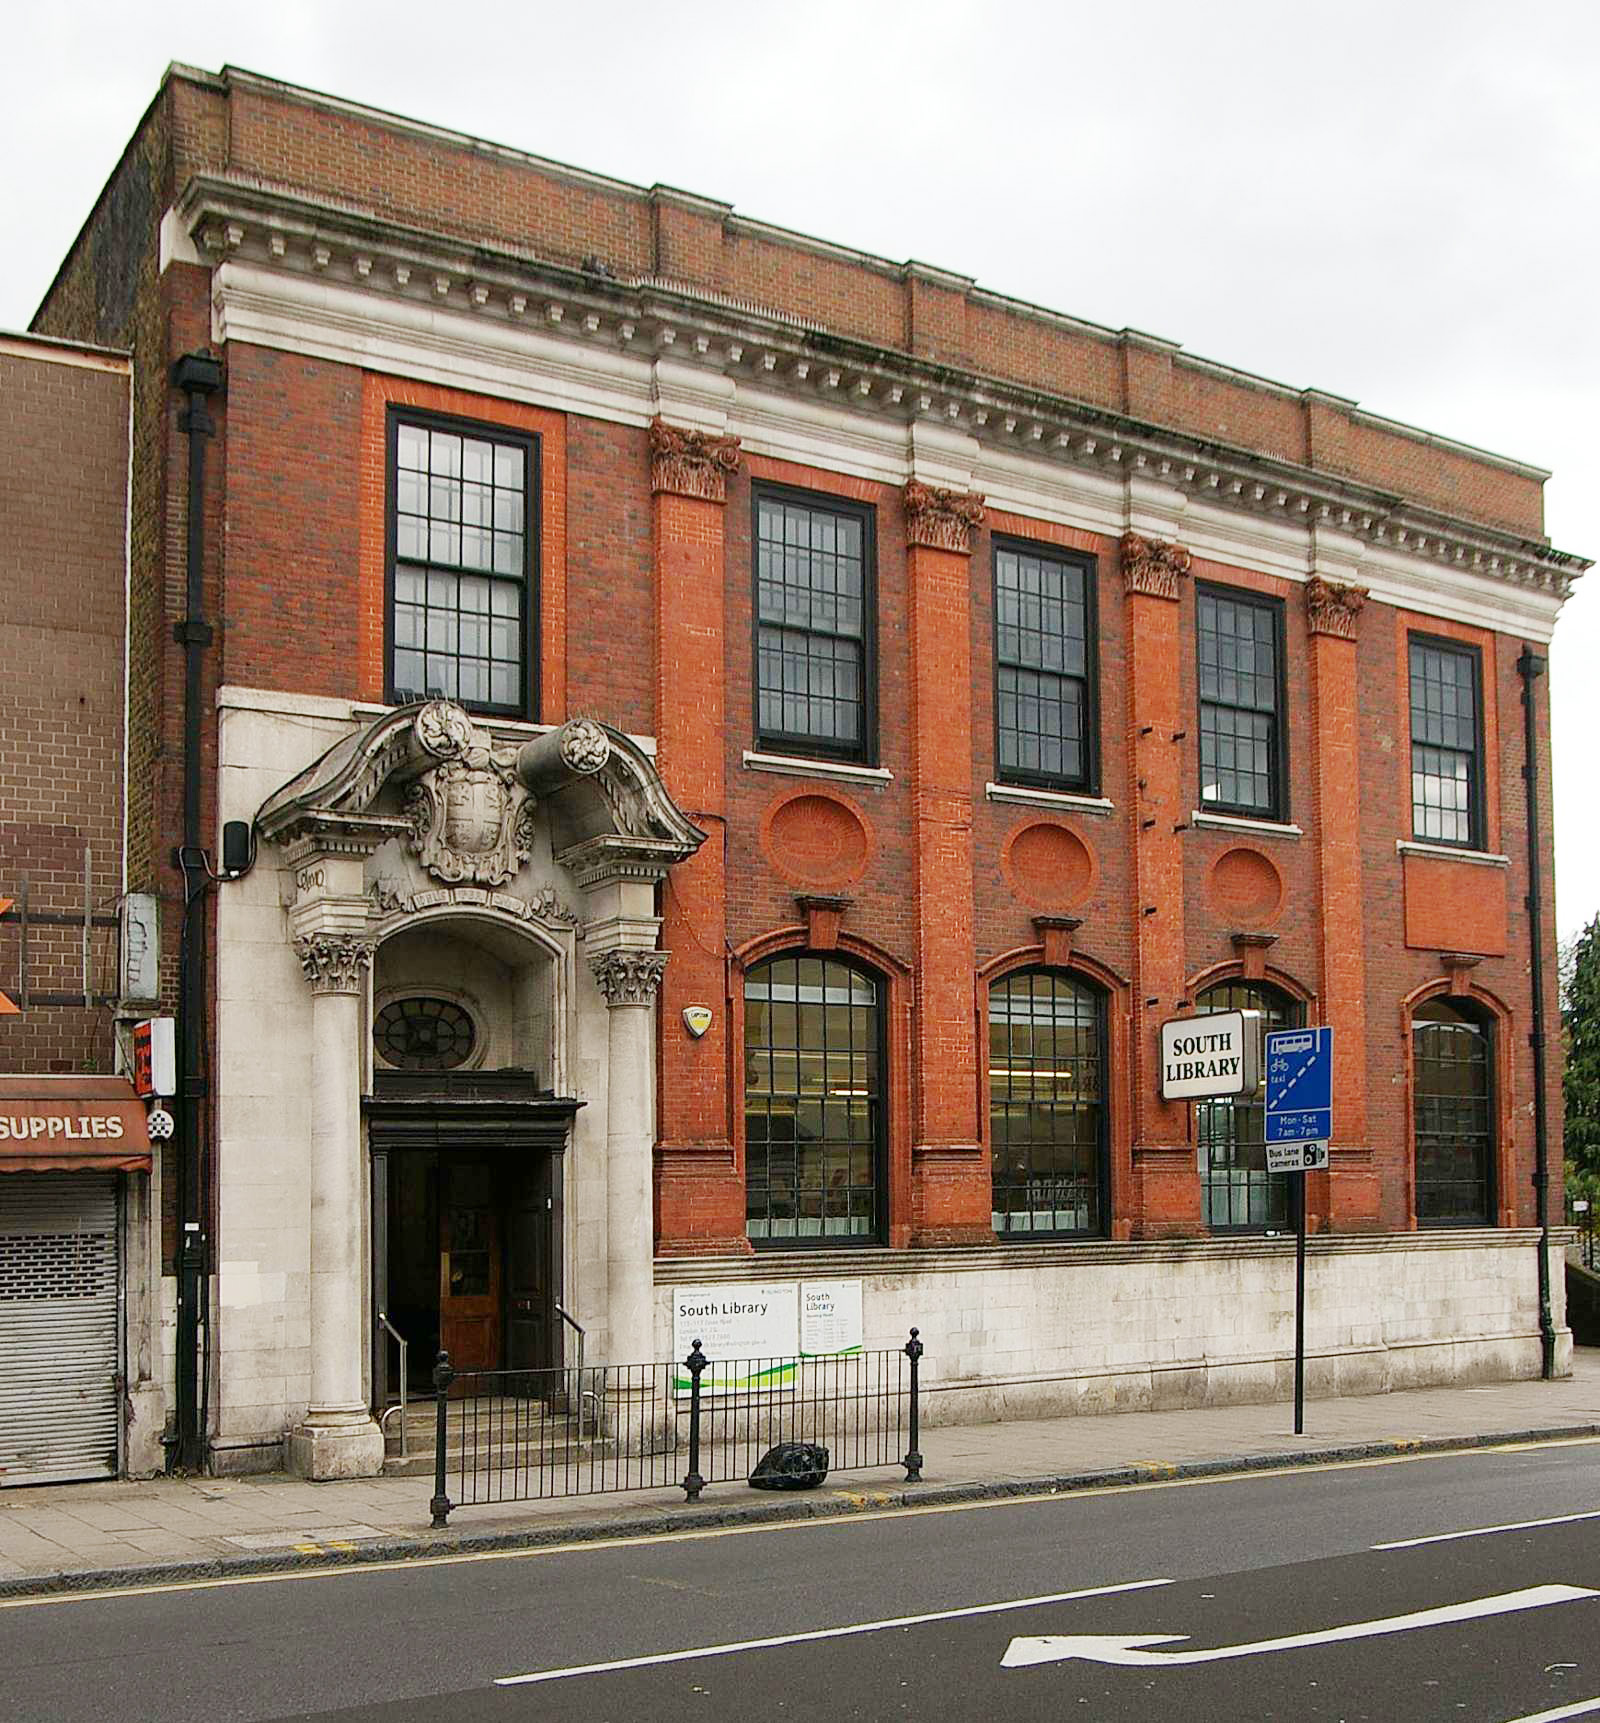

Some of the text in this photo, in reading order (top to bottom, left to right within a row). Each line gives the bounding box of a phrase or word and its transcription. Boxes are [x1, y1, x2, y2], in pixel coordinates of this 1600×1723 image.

[1173, 1032, 1232, 1056] SOUTH
[1166, 1056, 1240, 1082] LIBRARY
[1270, 1075, 1286, 1083] taxi
[0, 1115, 125, 1140] SUPPLIES
[1269, 1149, 1300, 1159] Bus lane
[1270, 1161, 1299, 1169] cameras
[806, 1292, 830, 1302] South
[679, 1301, 769, 1317] South Library
[806, 1301, 835, 1312] Library
